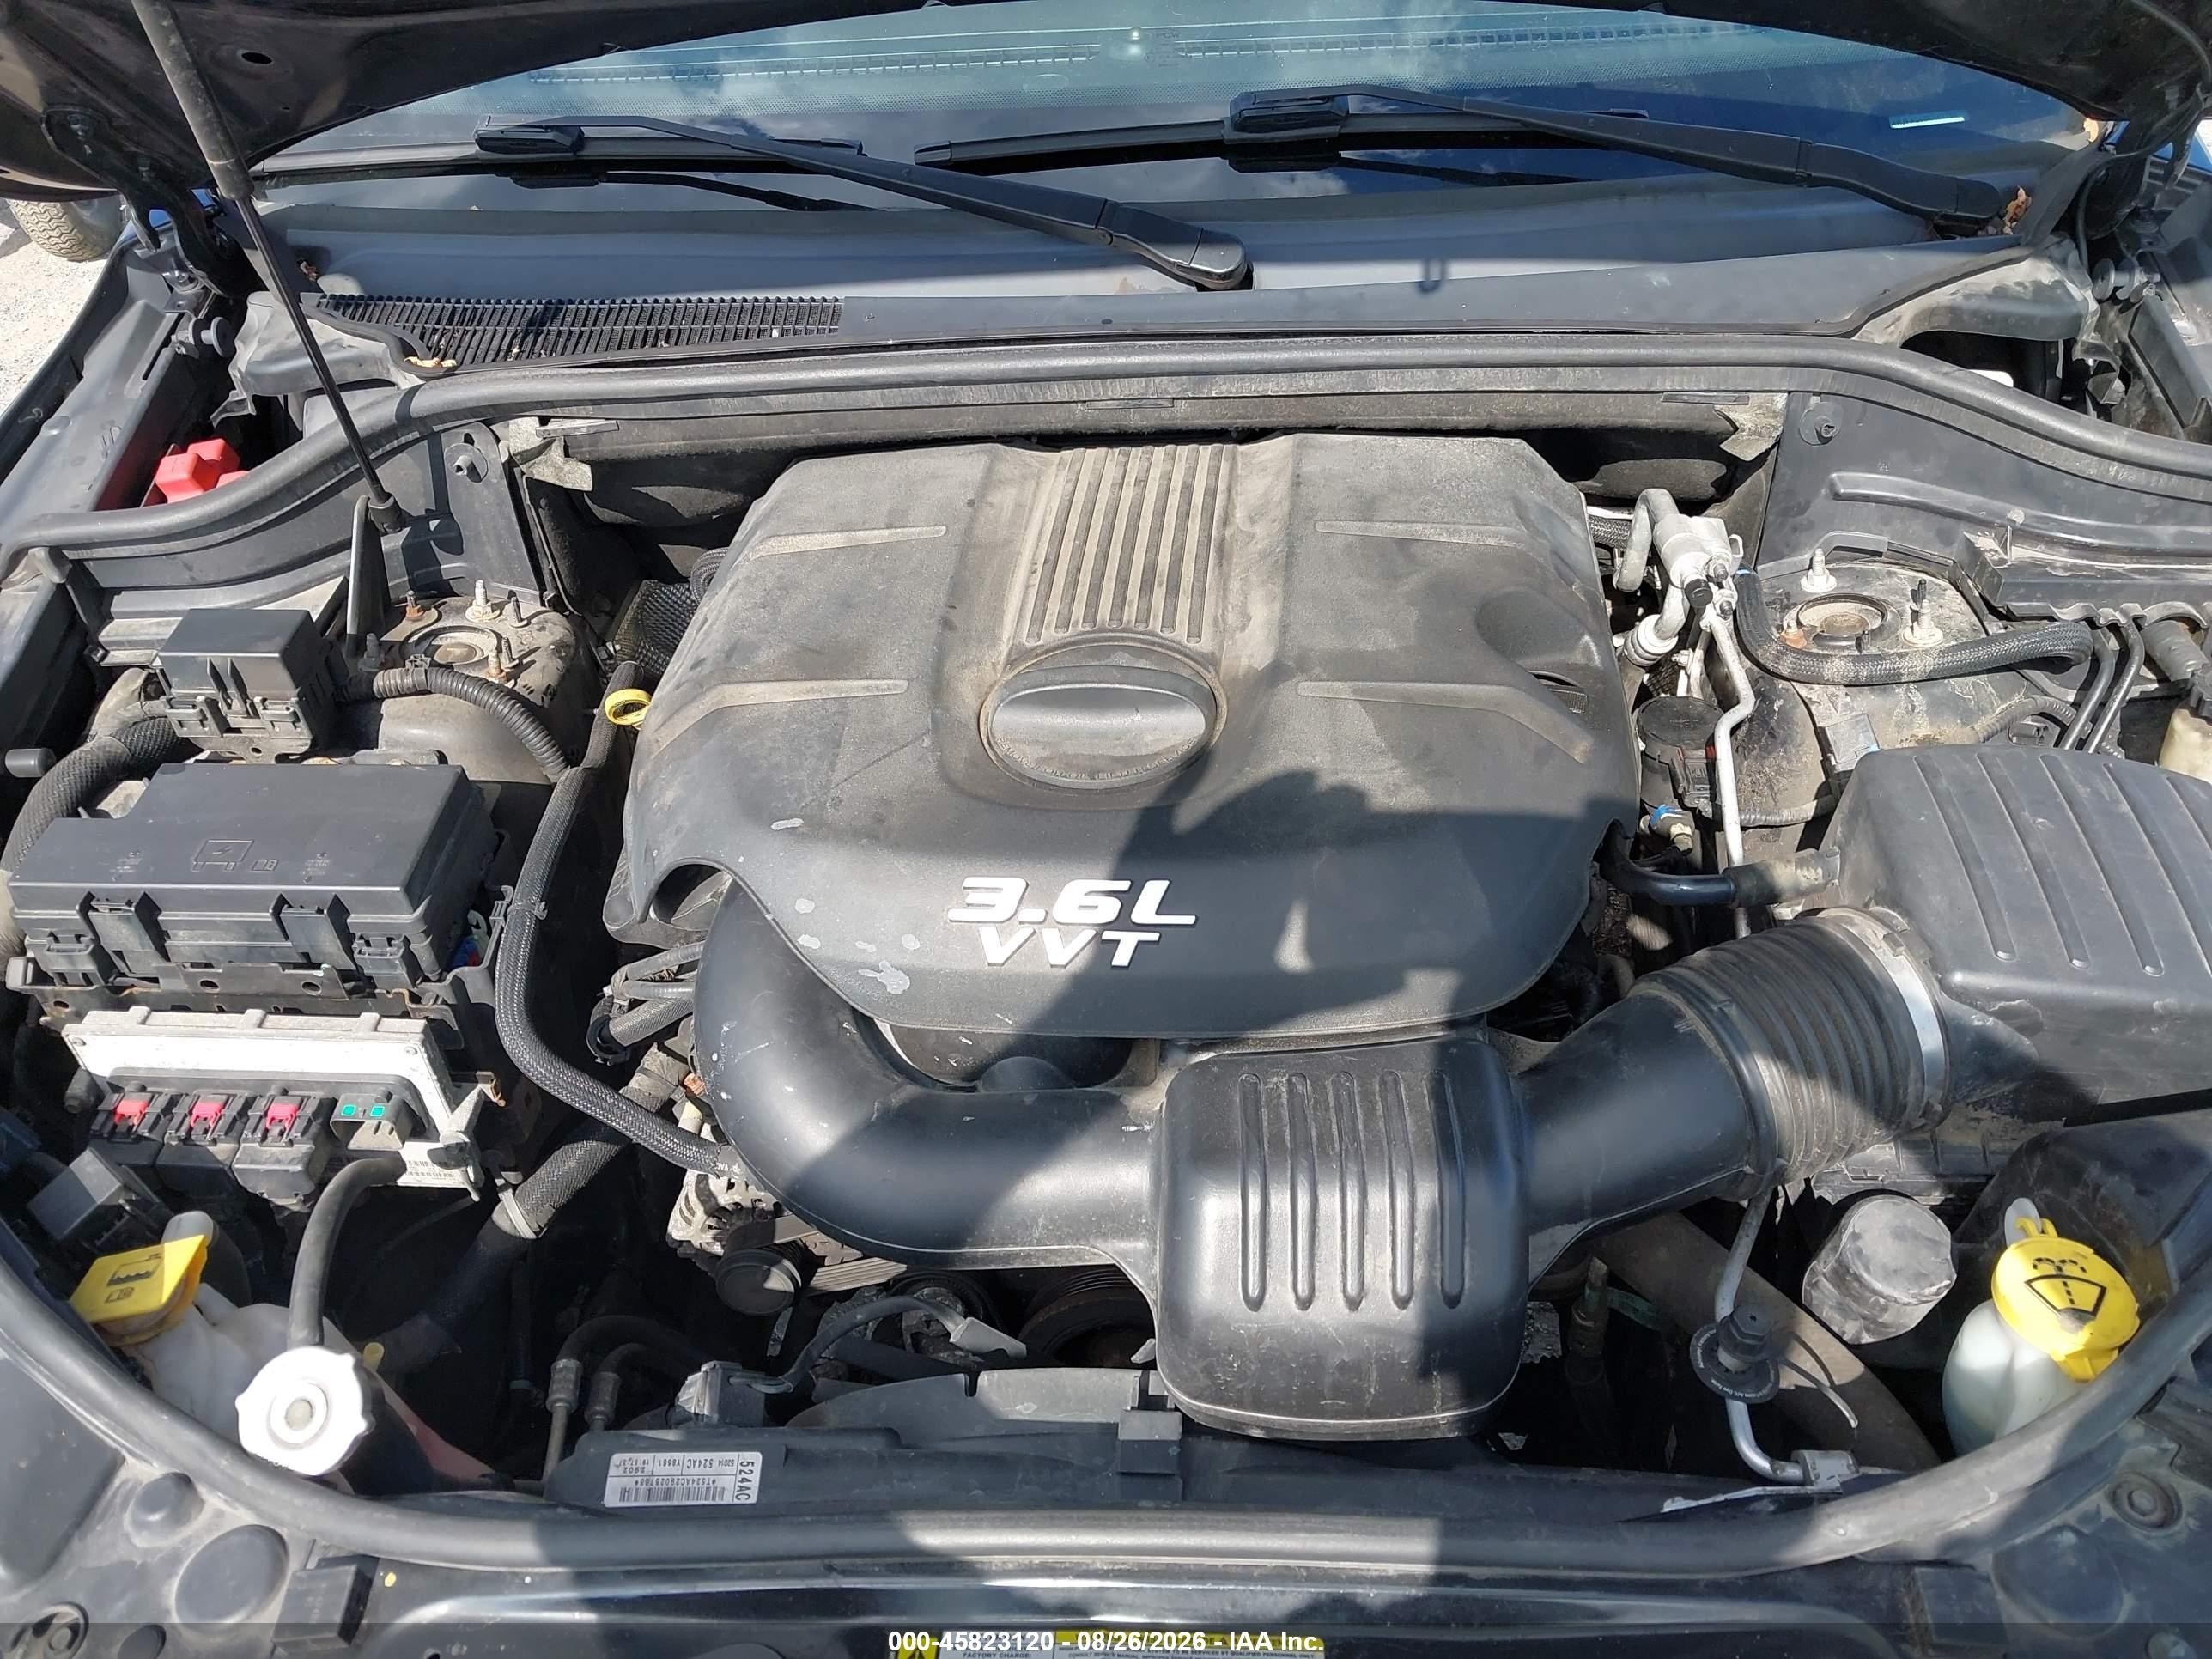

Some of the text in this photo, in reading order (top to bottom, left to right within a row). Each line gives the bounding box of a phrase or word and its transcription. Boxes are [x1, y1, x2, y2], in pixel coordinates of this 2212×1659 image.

[948, 877, 1198, 925] 3.6L
[979, 927, 1161, 969] VVT
[687, 1458, 714, 1469] 524AC
[735, 1461, 755, 1501] 524AC
